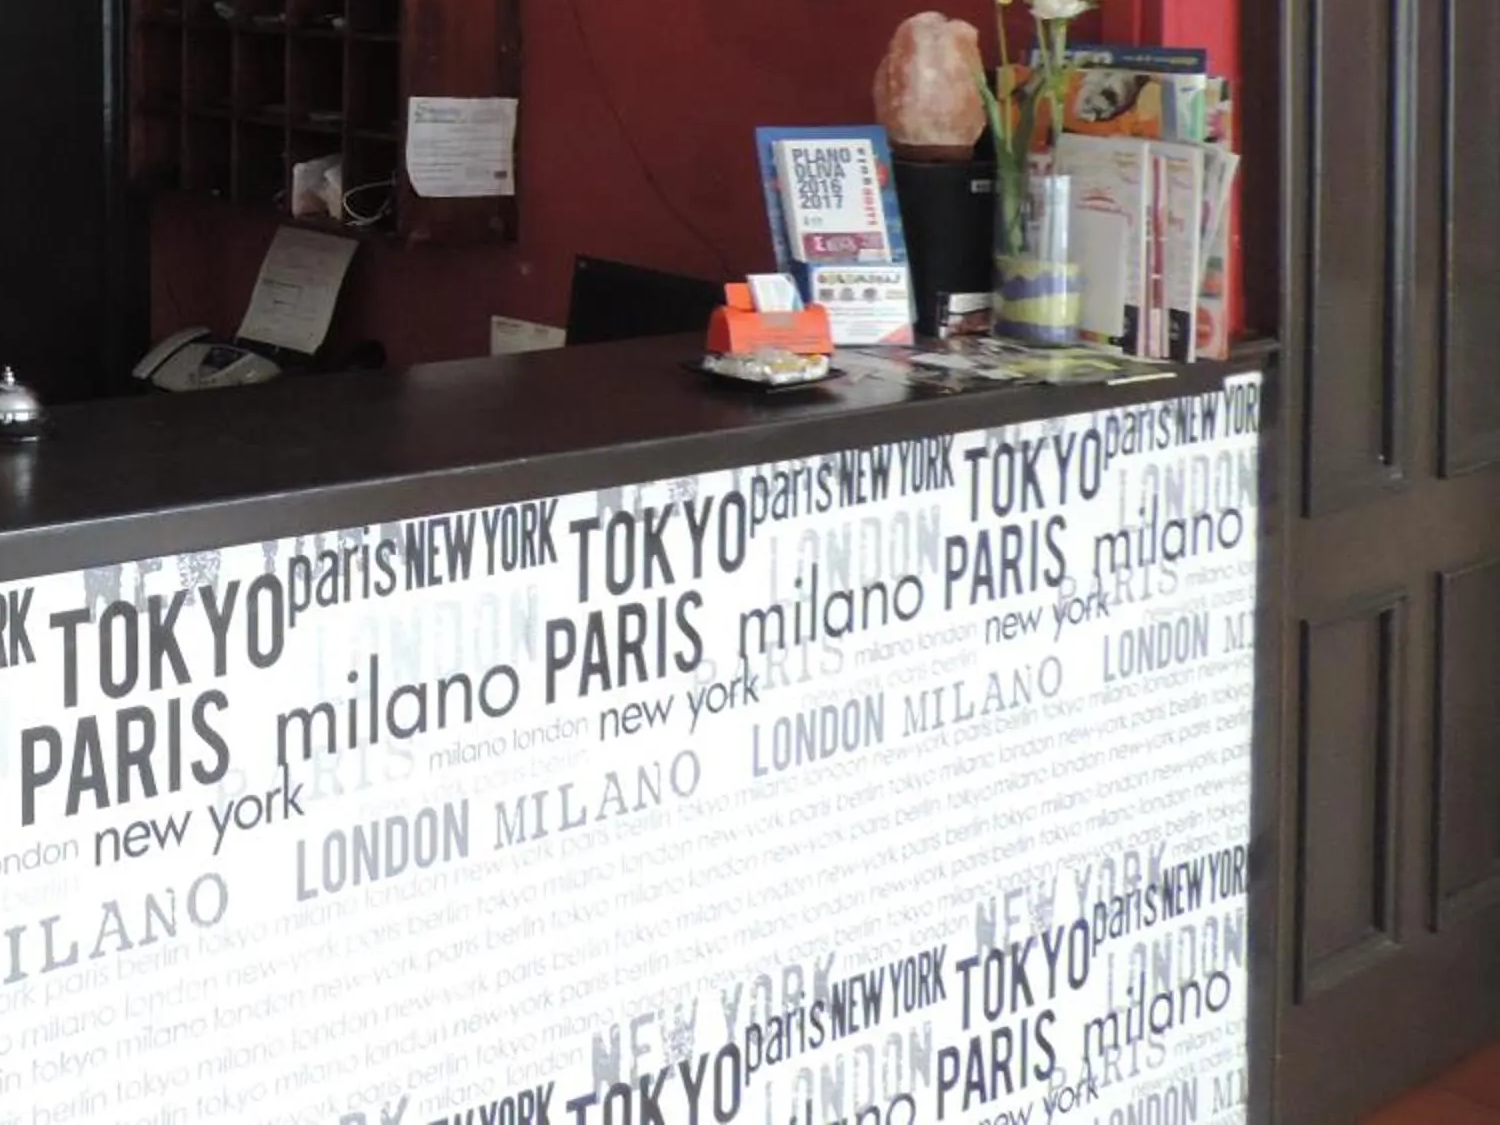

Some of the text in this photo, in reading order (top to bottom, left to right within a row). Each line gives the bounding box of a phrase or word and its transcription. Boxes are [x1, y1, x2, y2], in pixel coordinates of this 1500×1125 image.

[790, 147, 852, 165] PLANO
[799, 194, 844, 211] 2017
[748, 455, 835, 539] paris
[836, 441, 893, 508] NEW
[895, 430, 957, 497] YORK
[962, 422, 1102, 523] TOKYO
[1103, 403, 1172, 471] paris
[1173, 390, 1220, 447] NEW
[285, 517, 400, 629] paris
[402, 511, 477, 592] NEW
[480, 494, 560, 576] YORK
[567, 486, 747, 604] TOKYO
[1091, 475, 1244, 581] milano
[48, 569, 284, 709] TOKYO
[737, 560, 924, 662] milano
[943, 513, 1067, 612] PARIS
[984, 605, 1043, 645] new
[1052, 572, 1110, 642] york
[275, 652, 520, 770] milano
[544, 588, 705, 705] PARIS
[599, 693, 675, 742] new
[682, 654, 760, 734] york
[1102, 610, 1209, 683] LONDON
[19, 687, 230, 827] PARIS
[428, 715, 589, 773] milano london
[751, 689, 884, 778] LONDON
[901, 654, 1063, 738] MILANO
[93, 809, 193, 867] new
[205, 761, 305, 856] york
[296, 797, 469, 902] LONDON
[492, 748, 701, 851] MILANO
[1091, 865, 1159, 958] paris
[1160, 854, 1206, 922] NEW
[743, 942, 948, 1088] paris NEW YORK
[954, 911, 1090, 1032] TOKYO
[1081, 935, 1233, 1067] milano
[935, 1007, 1057, 1121] PARIS
[1041, 1072, 1099, 1125] york
